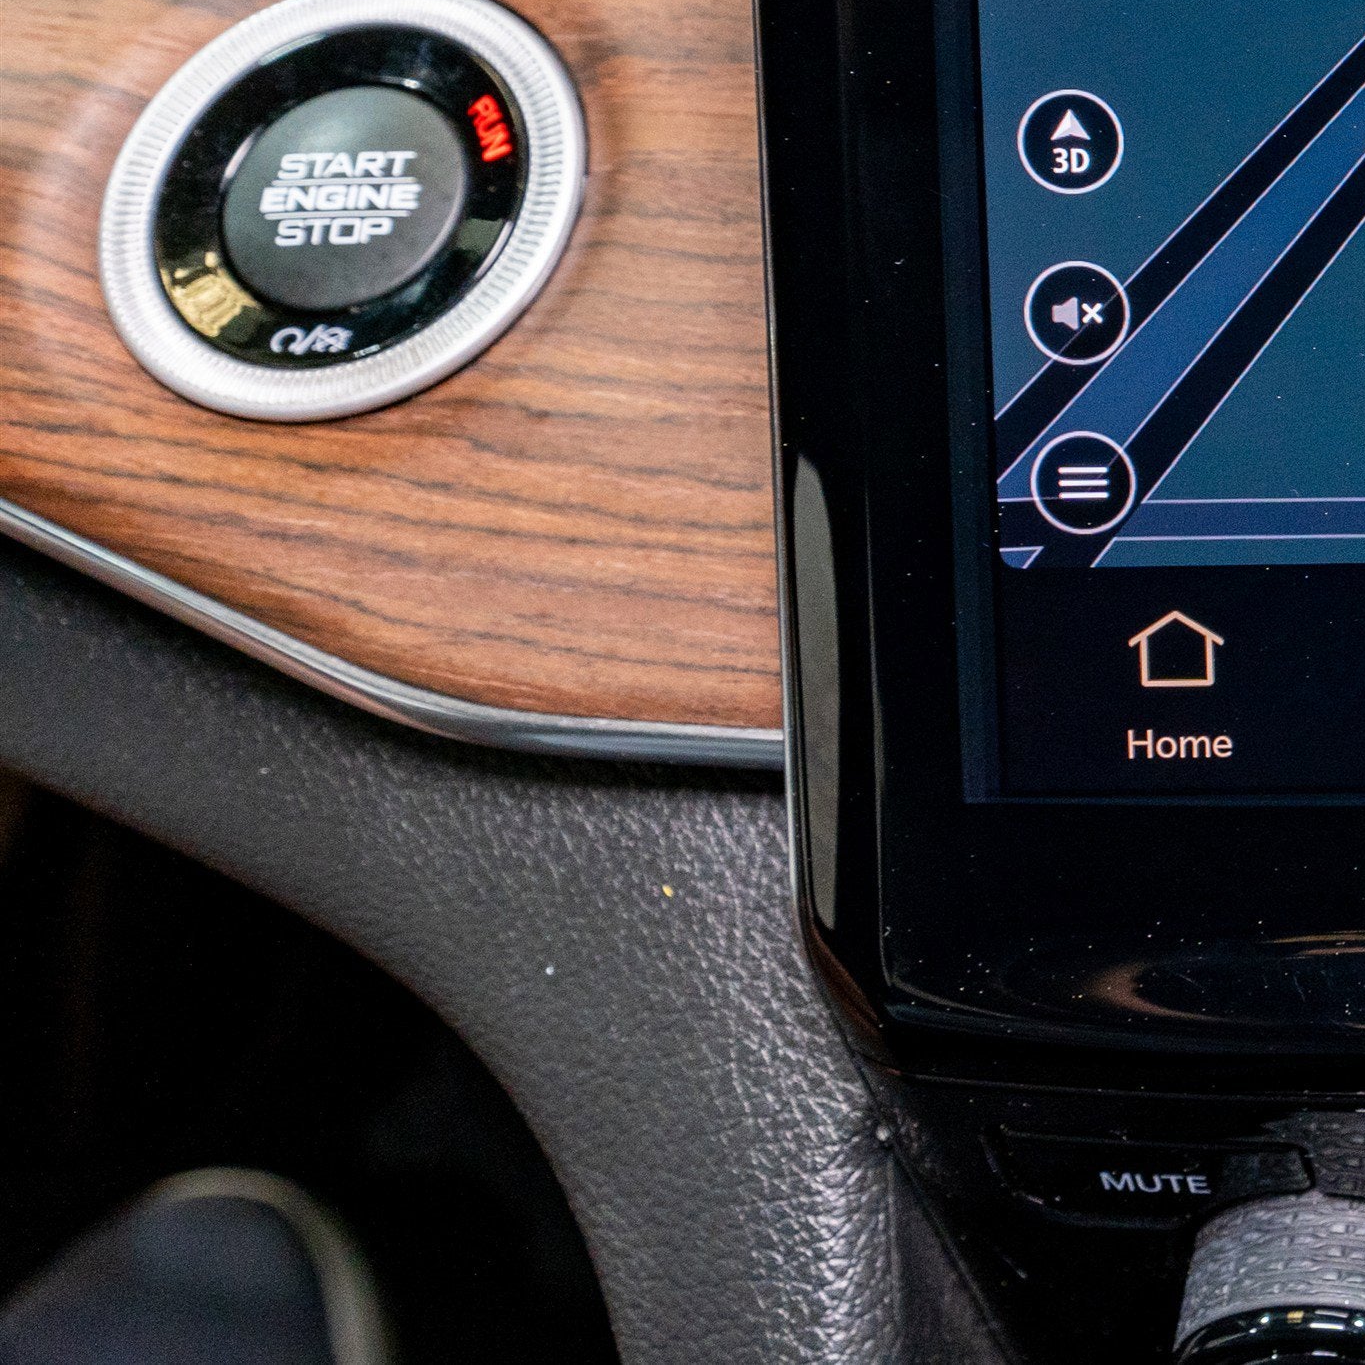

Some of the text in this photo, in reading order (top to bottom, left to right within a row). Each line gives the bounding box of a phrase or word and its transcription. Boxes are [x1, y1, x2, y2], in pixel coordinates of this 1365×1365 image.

[468, 95, 512, 162] RUN
[278, 152, 416, 180] START
[1053, 148, 1089, 173] 3D
[259, 184, 421, 212] ENGINE
[275, 218, 392, 247] STOP
[1128, 730, 1232, 759] Home
[1100, 1172, 1210, 1194] MUTE
